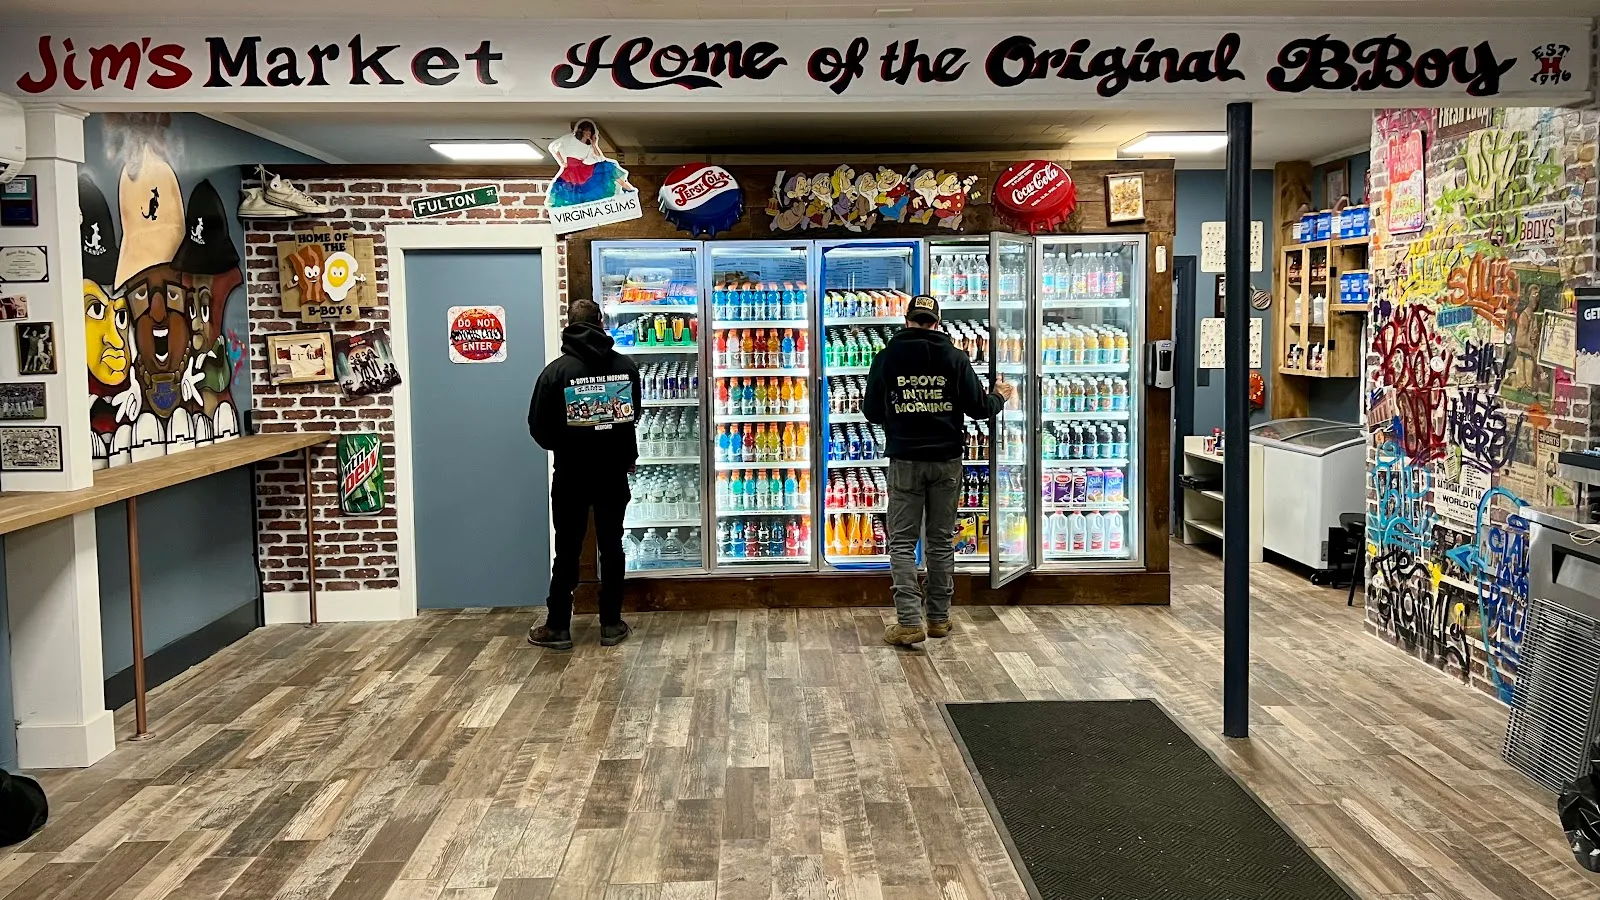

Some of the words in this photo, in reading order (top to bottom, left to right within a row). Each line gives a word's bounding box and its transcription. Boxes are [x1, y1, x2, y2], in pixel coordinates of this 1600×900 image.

[16, 36, 193, 93] Jim's
[202, 34, 503, 87] Market
[551, 35, 788, 90] Home
[807, 37, 869, 95] of
[880, 38, 971, 85] the
[985, 32, 1245, 98] Original
[1266, 33, 1518, 96] B.Boy
[1530, 70, 1572, 85] 1976
[417, 193, 476, 215] FULTON
[486, 189, 494, 197] ST
[554, 207, 604, 223] VIRGINIA
[604, 198, 636, 215] SLIMS
[298, 233, 330, 243] HOME
[334, 233, 349, 241] OF
[323, 243, 346, 252] THE
[308, 305, 352, 315] B-BOYS
[457, 319, 471, 328] DO
[477, 318, 496, 328] NOT
[462, 341, 493, 351] ENTER
[589, 376, 596, 384] IN
[596, 375, 606, 383] THE
[606, 373, 630, 382] MORNING
[896, 375, 946, 387] B-BOYS
[902, 388, 916, 400] IN
[915, 388, 943, 400] THE
[894, 402, 953, 414] MORNING
[1538, 432, 1561, 448] SPORTS
[1089, 477, 1102, 486] Silk
[1108, 477, 1123, 487] Silk
[1437, 479, 1461, 493] SATURDAY
[1461, 486, 1474, 499] JULY
[1474, 490, 1481, 500] 18
[1442, 494, 1469, 509] WORLD
[966, 516, 975, 525] 40
